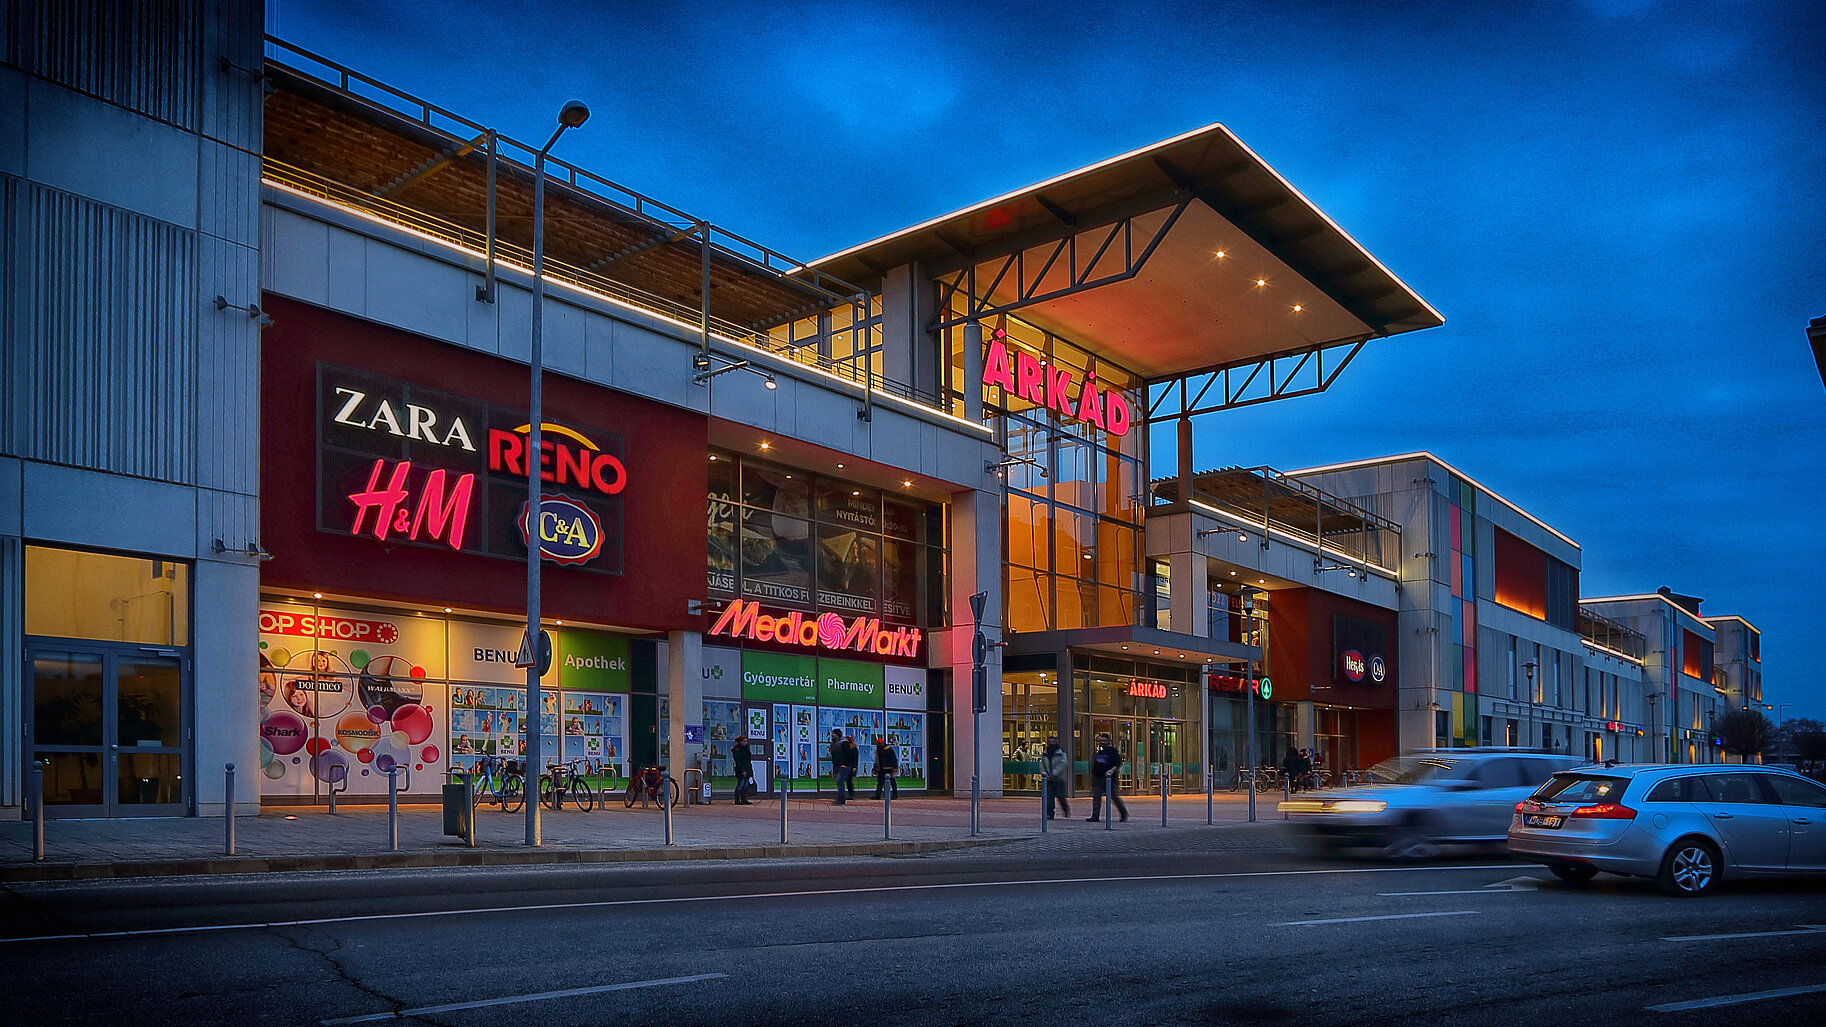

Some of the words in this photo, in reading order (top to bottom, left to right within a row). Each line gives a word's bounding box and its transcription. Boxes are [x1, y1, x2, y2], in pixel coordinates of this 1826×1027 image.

[982, 328, 1130, 436] ÁRKÁD
[333, 386, 477, 452] ZARA
[488, 428, 627, 495] RENO
[348, 458, 475, 550] H&M
[538, 510, 591, 549] C&A
[754, 583, 763, 594] A
[764, 585, 799, 600] TITKOS
[300, 617, 371, 639] SHOP
[707, 598, 819, 647] Media
[841, 616, 922, 658] Markt
[474, 648, 518, 664] BENU
[564, 653, 626, 671] Apothek
[743, 671, 815, 688] Gyógyszertár
[827, 678, 875, 694] Pharmacy
[888, 683, 913, 695] BENU
[1128, 677, 1168, 699] ÁRKÁD
[265, 726, 302, 737] Shark
